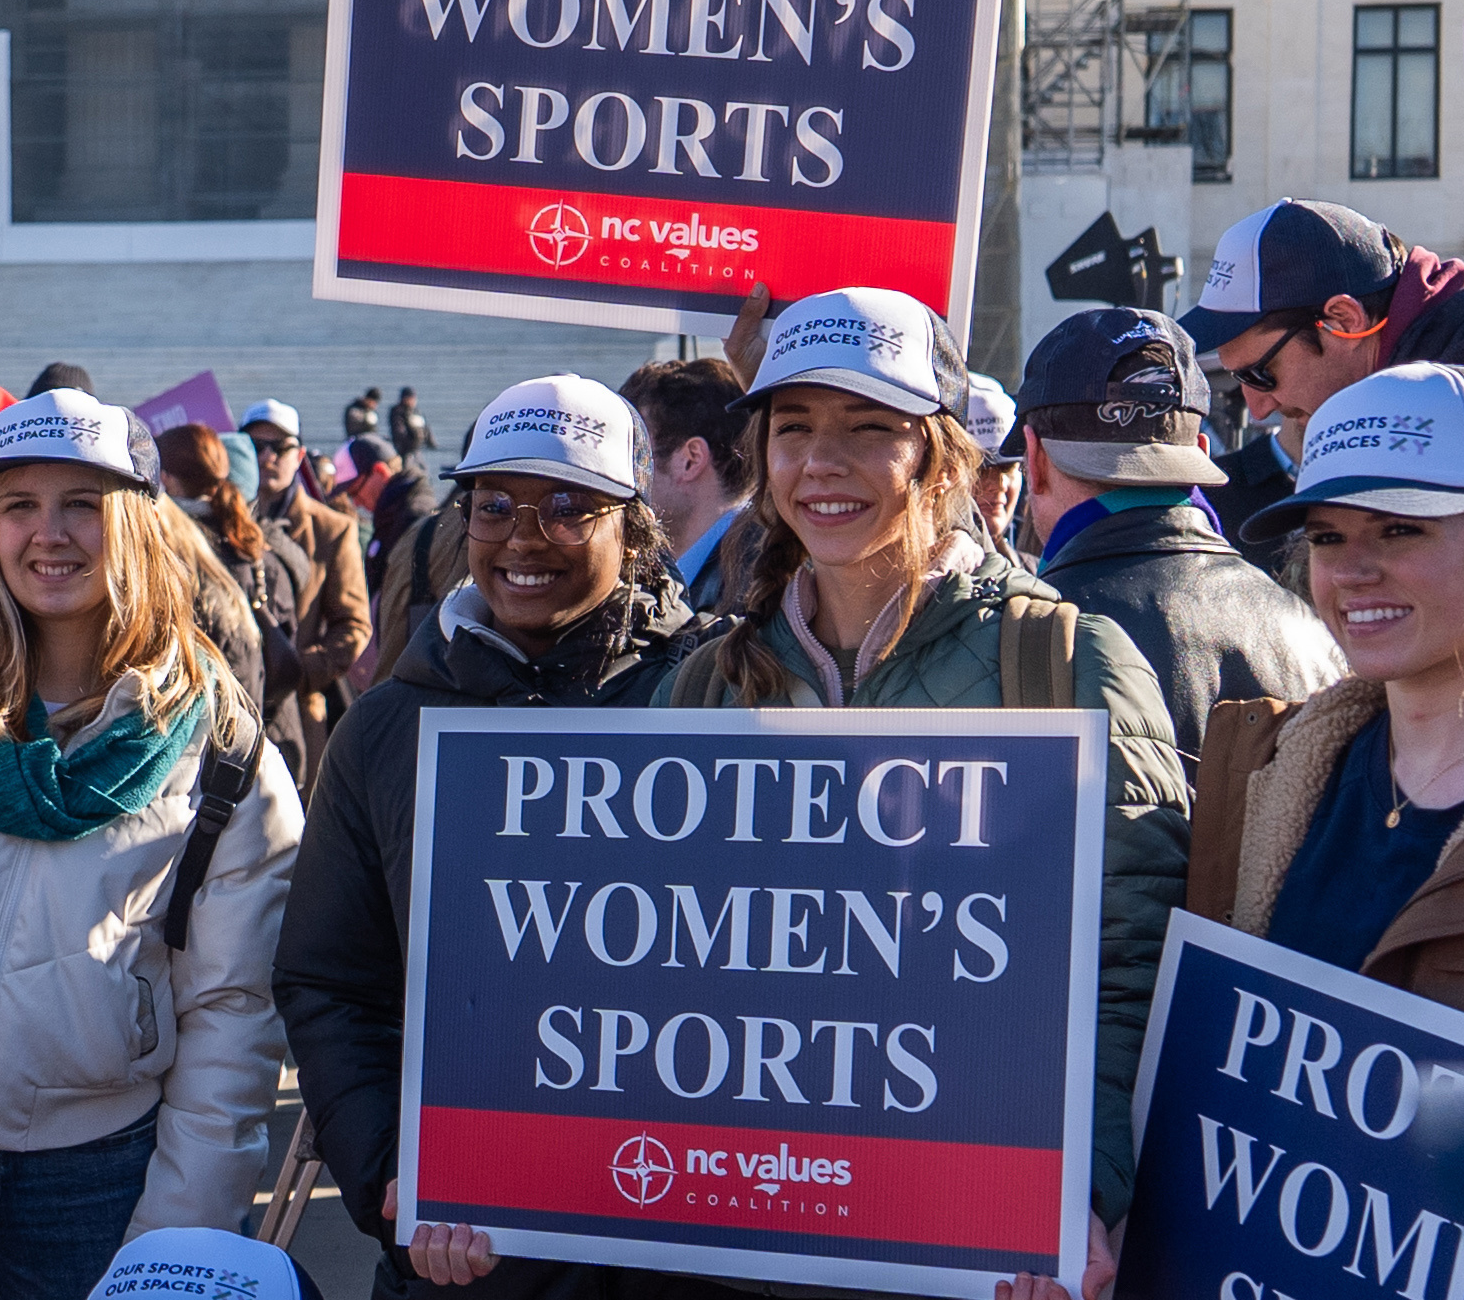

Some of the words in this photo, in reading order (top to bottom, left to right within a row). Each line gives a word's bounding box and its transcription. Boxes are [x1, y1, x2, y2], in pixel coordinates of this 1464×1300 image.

[456, 82, 844, 188] SPORTS
[601, 216, 641, 241] nc
[649, 212, 759, 253] values
[600, 255, 756, 281] COALITION
[775, 324, 801, 345] OUR
[804, 318, 867, 332] SPORTS
[771, 340, 797, 361] OUR
[800, 333, 861, 347] SPACES
[19, 416, 69, 429] SPORTS
[489, 410, 516, 425] OUR
[517, 408, 572, 423] SPORTS
[1325, 417, 1388, 439] SPORTS
[16, 429, 65, 442] SPACES
[485, 424, 511, 439] OUR
[513, 422, 567, 436] SPACES
[1320, 435, 1381, 456] SPACES
[496, 755, 1008, 848] PROTECT
[535, 1005, 938, 1113] SPORTS
[686, 1148, 729, 1177] nc
[735, 1142, 853, 1186] values
[686, 1192, 850, 1217] COALITION
[112, 1262, 145, 1280] OUR
[148, 1261, 216, 1280] SPORTS
[104, 1279, 138, 1297] OUR
[140, 1278, 207, 1296] SPACES
